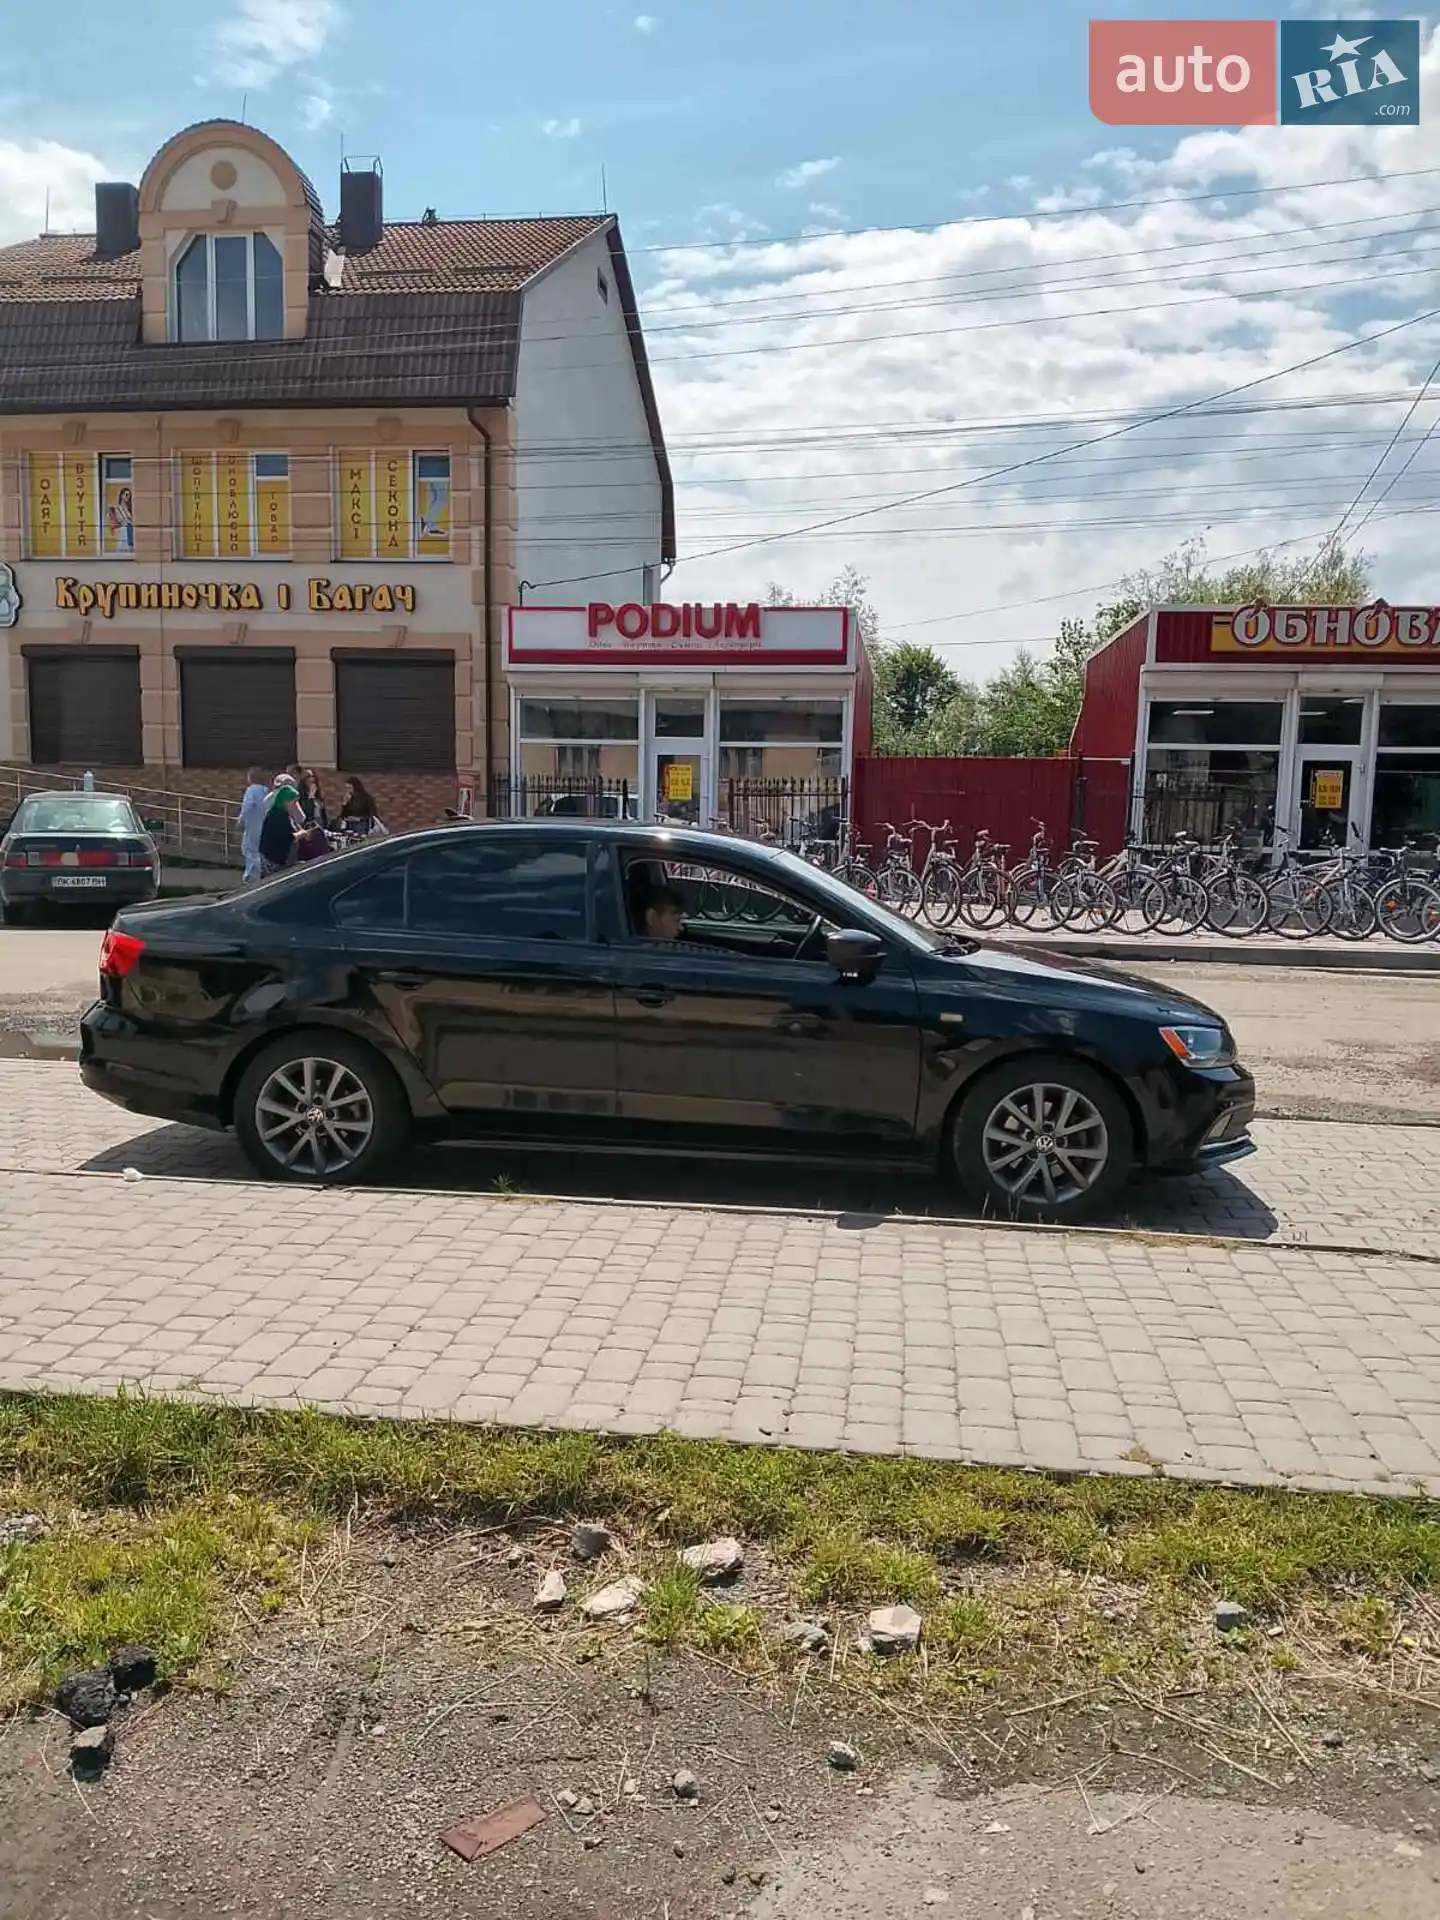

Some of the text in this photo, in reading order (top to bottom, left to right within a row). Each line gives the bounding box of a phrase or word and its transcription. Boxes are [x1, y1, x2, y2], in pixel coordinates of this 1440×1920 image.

[55, 576, 263, 618] Крупиночка
[308, 577, 417, 613] Багач
[588, 602, 761, 639] PODIUM
[1231, 600, 1440, 647] ОБНОВ
